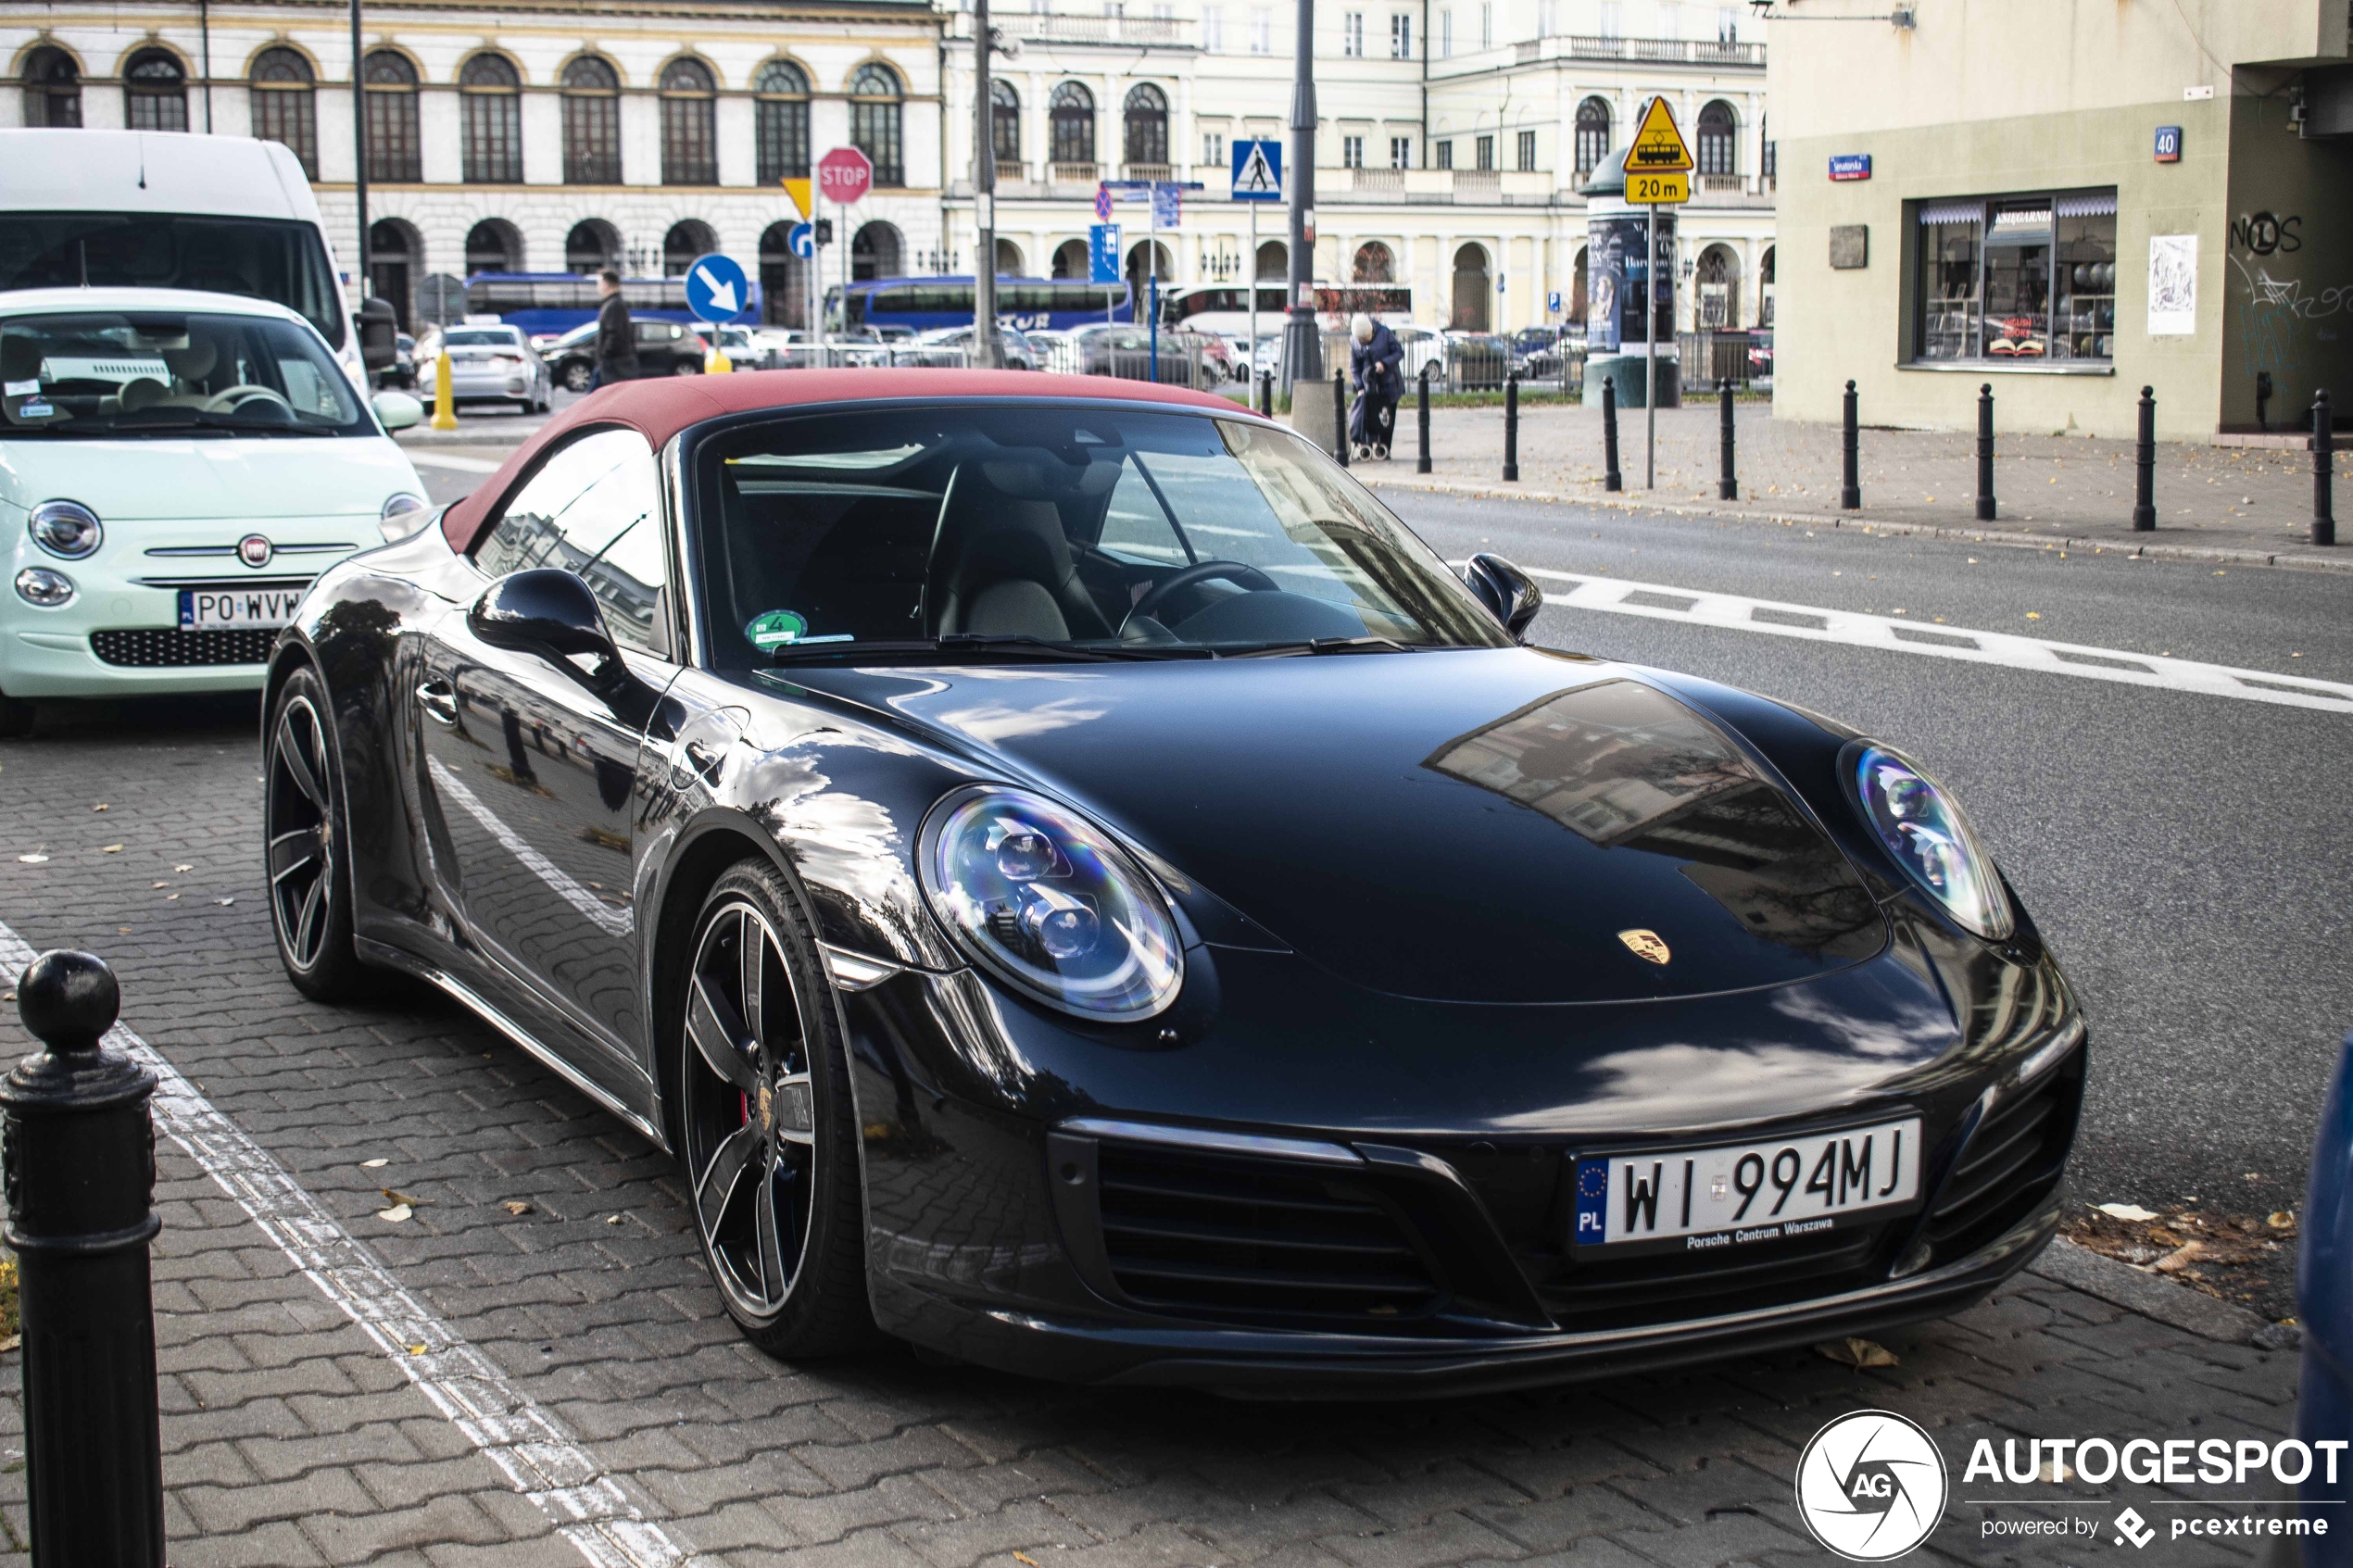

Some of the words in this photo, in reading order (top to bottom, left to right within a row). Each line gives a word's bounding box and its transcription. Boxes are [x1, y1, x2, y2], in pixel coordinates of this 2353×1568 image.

[2158, 134, 2174, 154] 40
[821, 167, 867, 186] STOP
[1639, 180, 1660, 197] 20
[1664, 183, 1678, 197] m
[973, 313, 1051, 331] TUR
[2003, 318, 2032, 327] ENGLISH
[2004, 328, 2032, 339] BOOKS
[769, 615, 785, 632] 4
[1624, 1157, 1695, 1235] WI
[1730, 1126, 1901, 1222] 994MJ
[1579, 1211, 1602, 1232] PL
[1687, 1233, 1730, 1249] Porsche
[1735, 1226, 1779, 1243] Centrum
[1784, 1217, 1833, 1236] Warszawa
